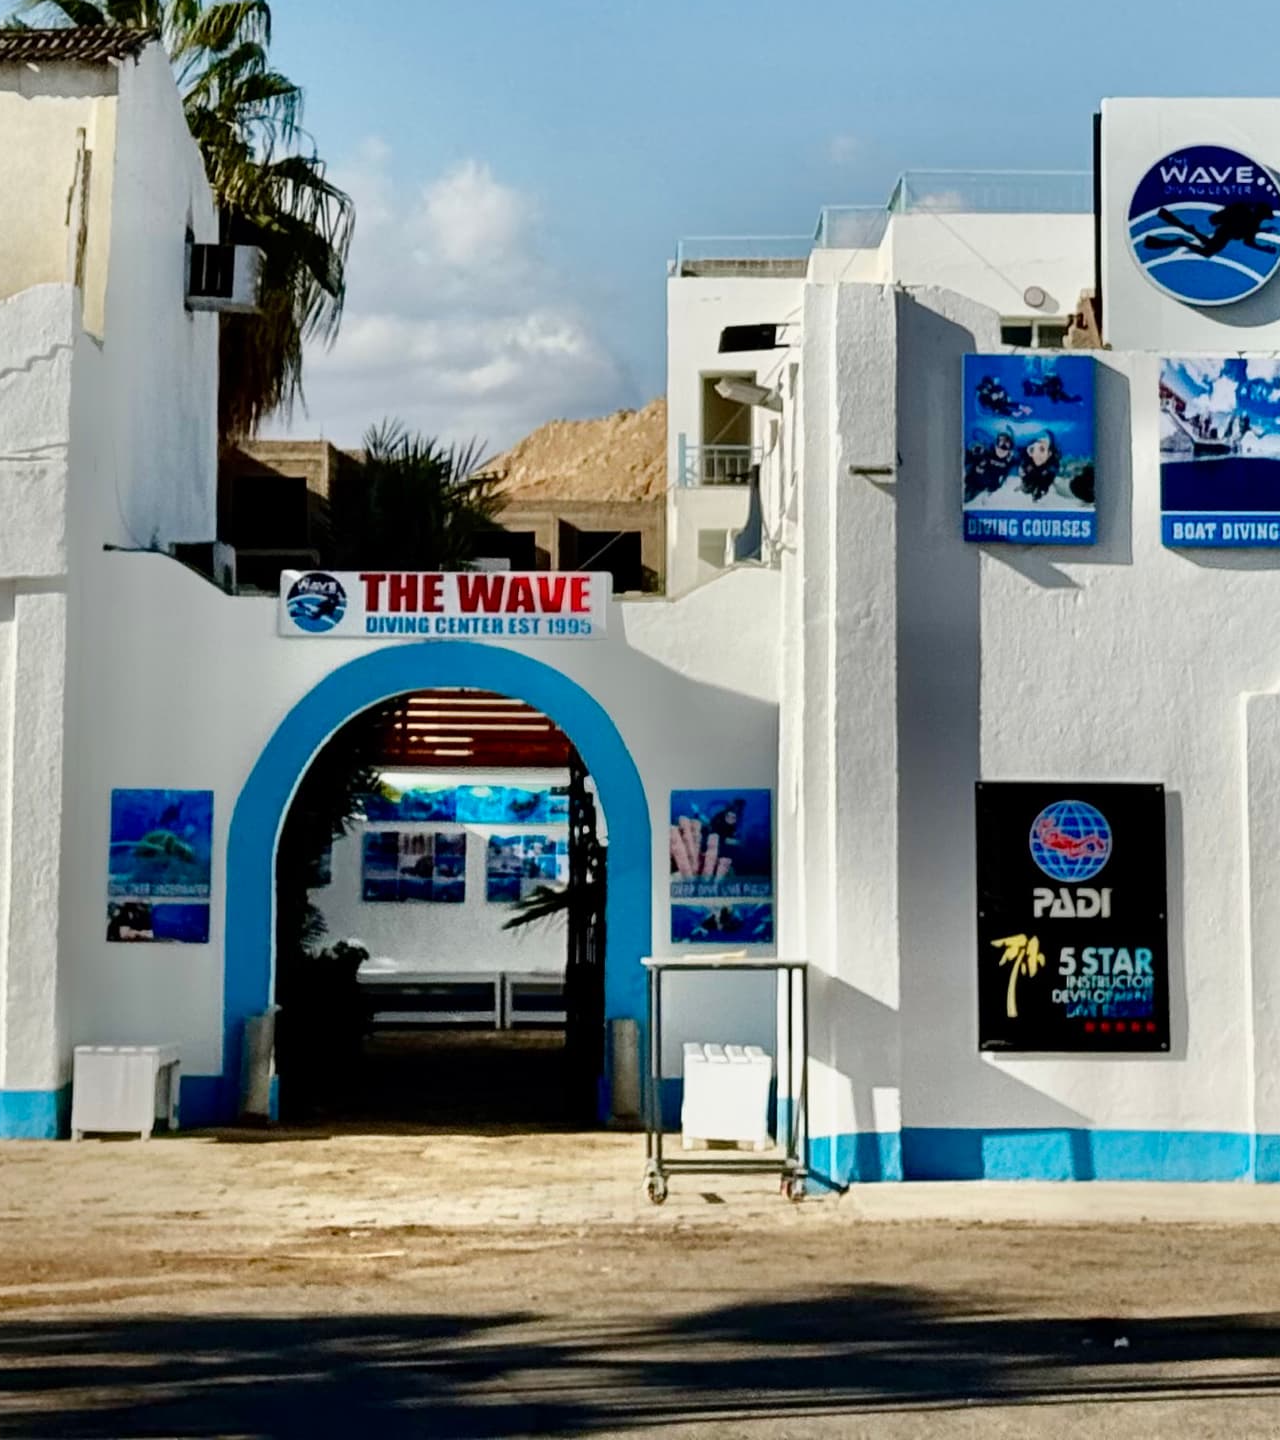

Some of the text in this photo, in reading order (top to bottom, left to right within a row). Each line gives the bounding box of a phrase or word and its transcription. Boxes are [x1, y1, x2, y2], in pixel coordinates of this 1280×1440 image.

[1160, 166, 1254, 183] WAVE
[968, 518, 1092, 537] DIVING COURSES
[1173, 522, 1279, 541] BOAT DIVING
[360, 574, 591, 613] THE WAVE
[366, 616, 591, 635] DIVING CENTER EST 1995
[1033, 888, 1112, 918] PADI
[1058, 947, 1154, 975] 5 STAR
[1066, 975, 1154, 988] INSTRUCTOR
